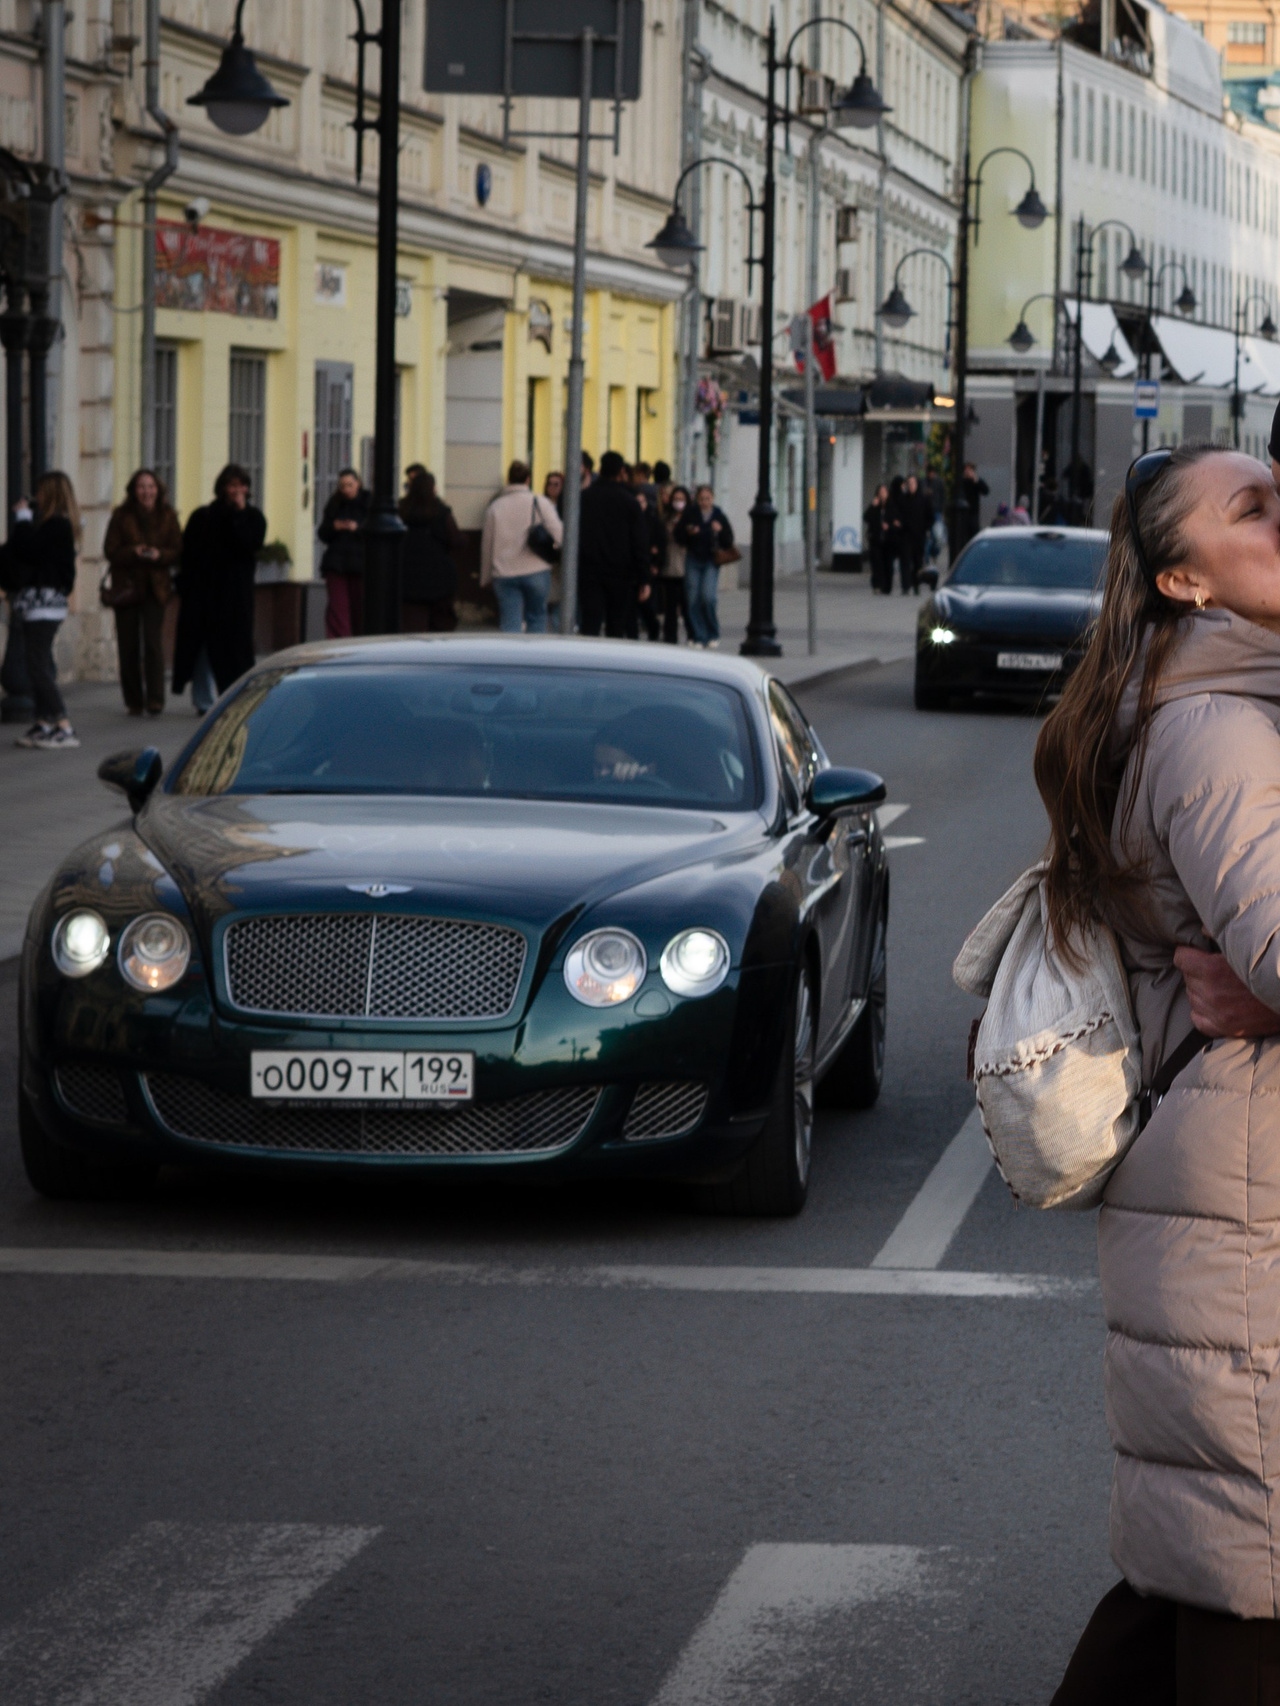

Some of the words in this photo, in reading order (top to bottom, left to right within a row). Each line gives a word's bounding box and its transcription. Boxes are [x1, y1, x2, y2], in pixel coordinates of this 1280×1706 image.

[263, 1057, 399, 1092] О009ТК
[410, 1056, 463, 1083] 199
[421, 1084, 447, 1094] RUS
